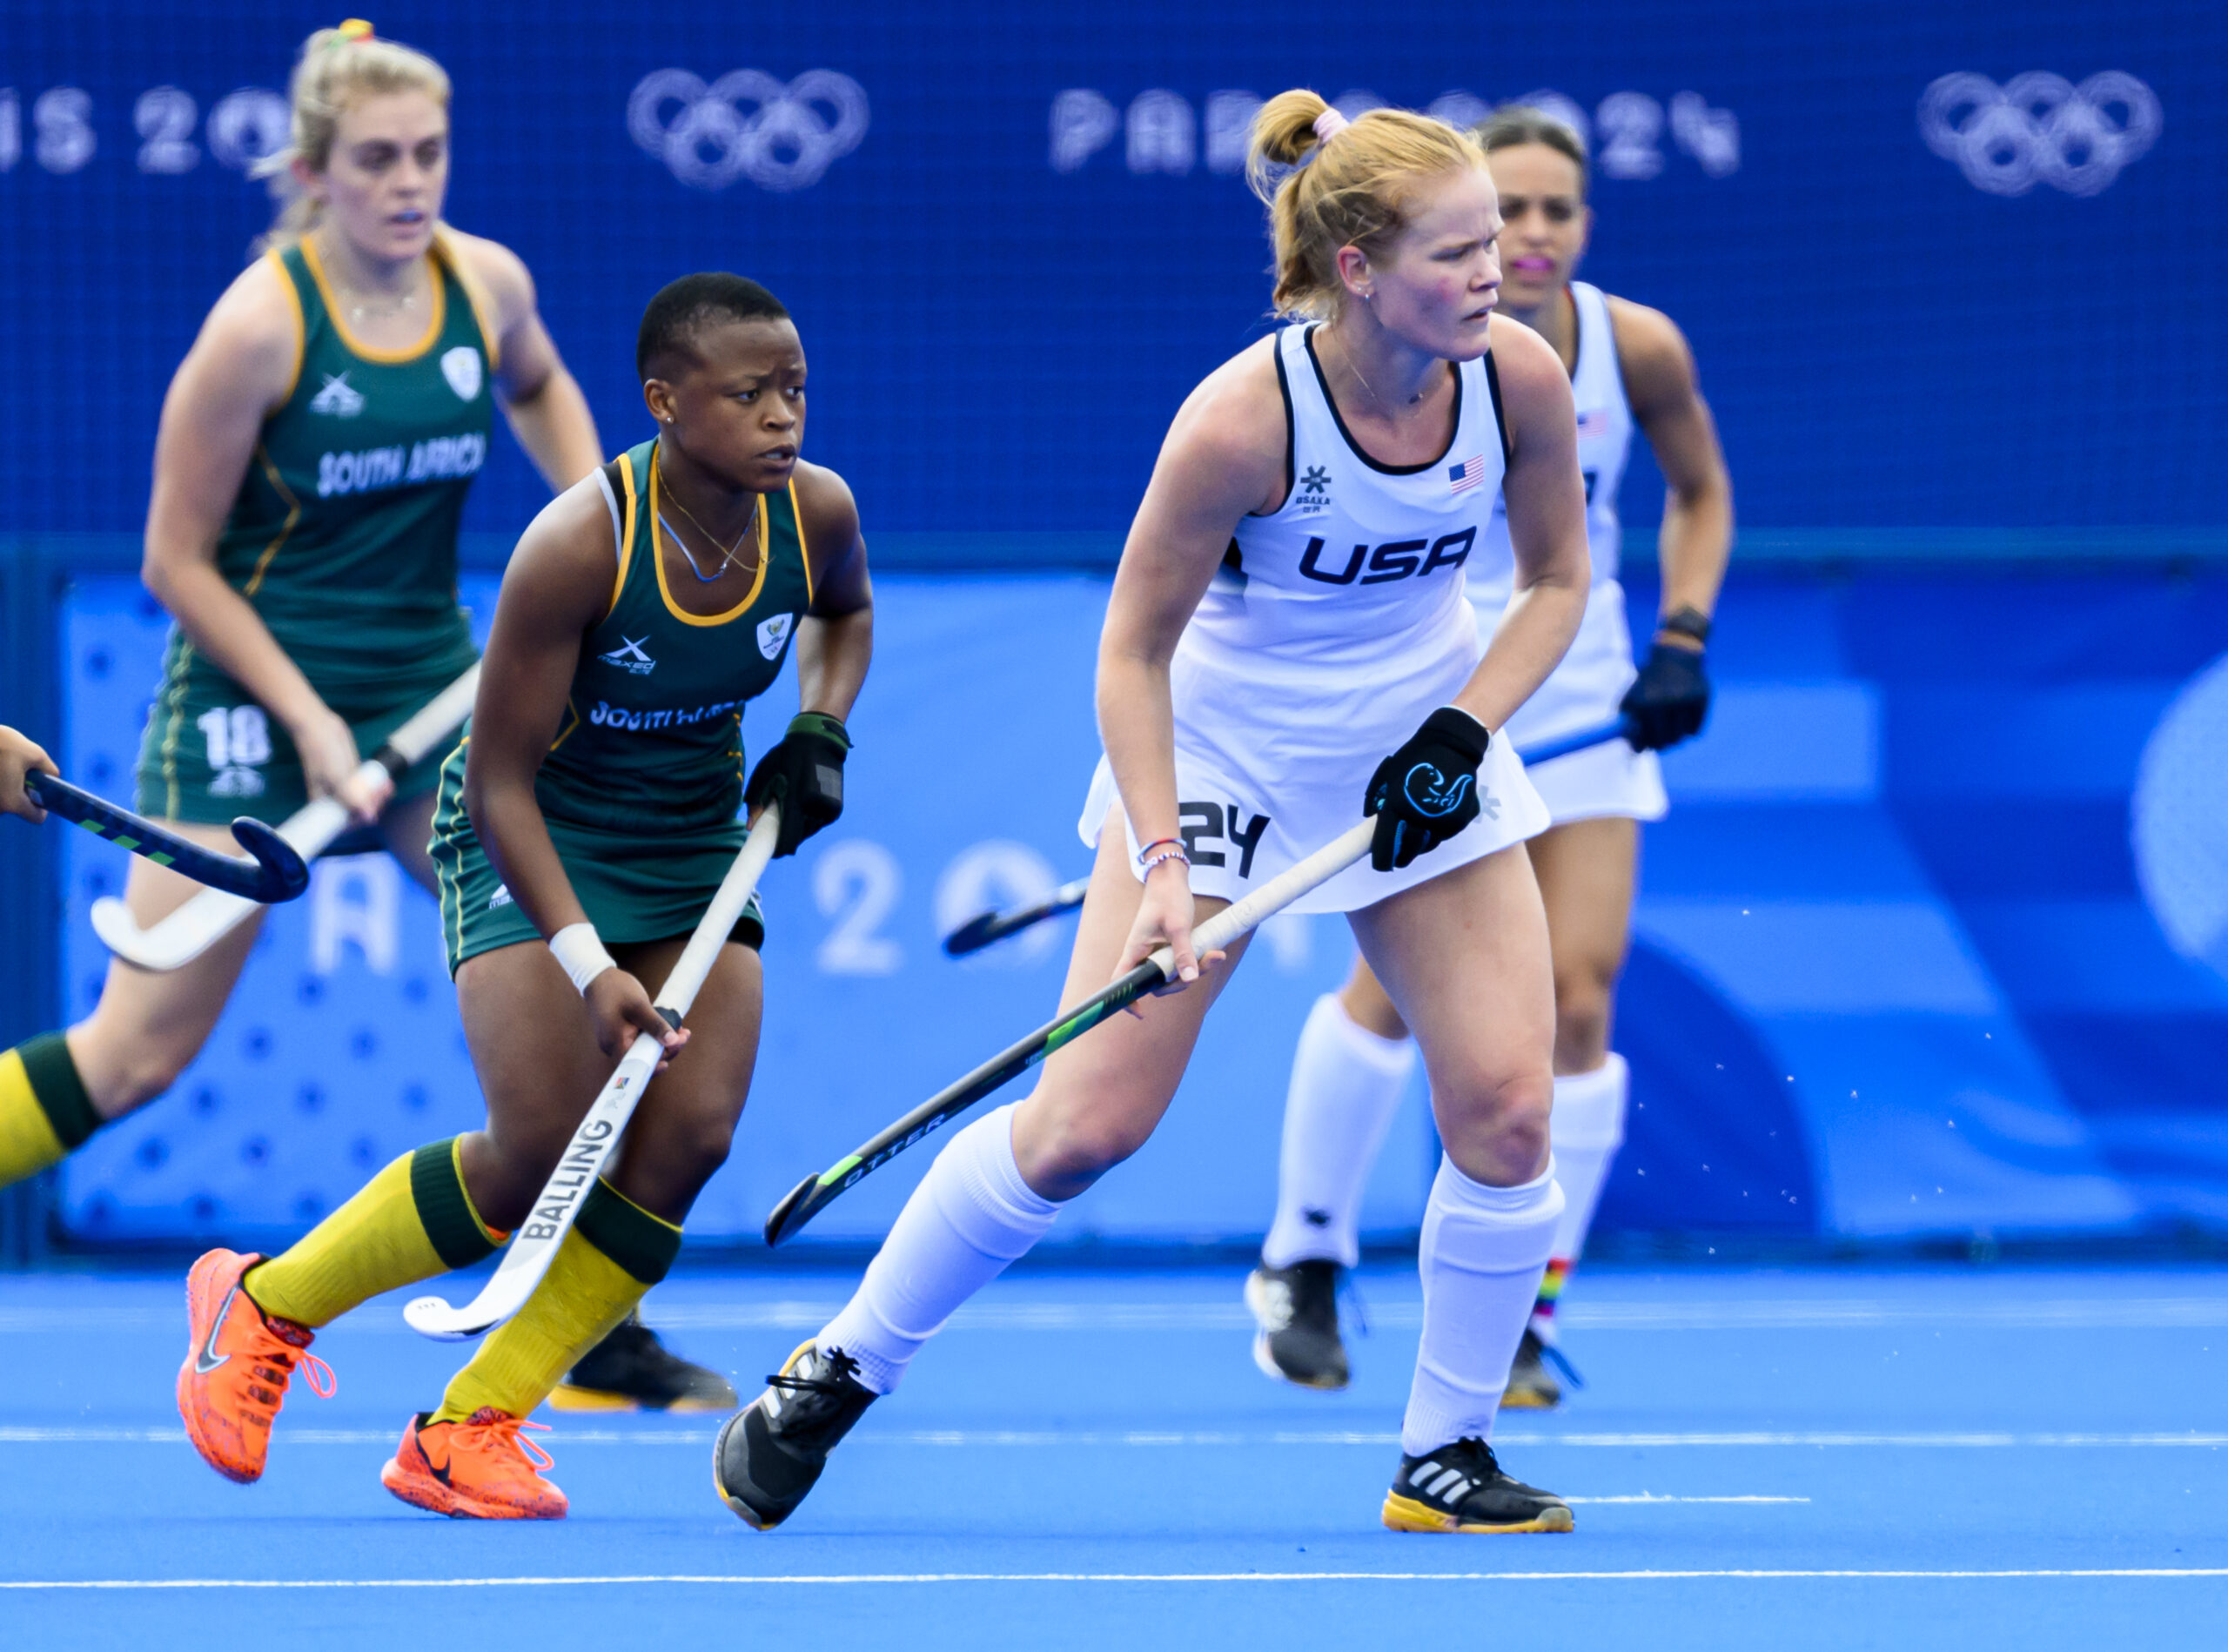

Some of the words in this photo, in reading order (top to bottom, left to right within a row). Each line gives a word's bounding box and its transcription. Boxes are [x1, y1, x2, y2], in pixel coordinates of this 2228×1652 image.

[1296, 496, 1331, 506] OSAKA
[1299, 525, 1478, 586] USA
[1178, 802, 1272, 880] 24
[521, 1119, 614, 1240] BALLING
[844, 1113, 946, 1189] OTTER
